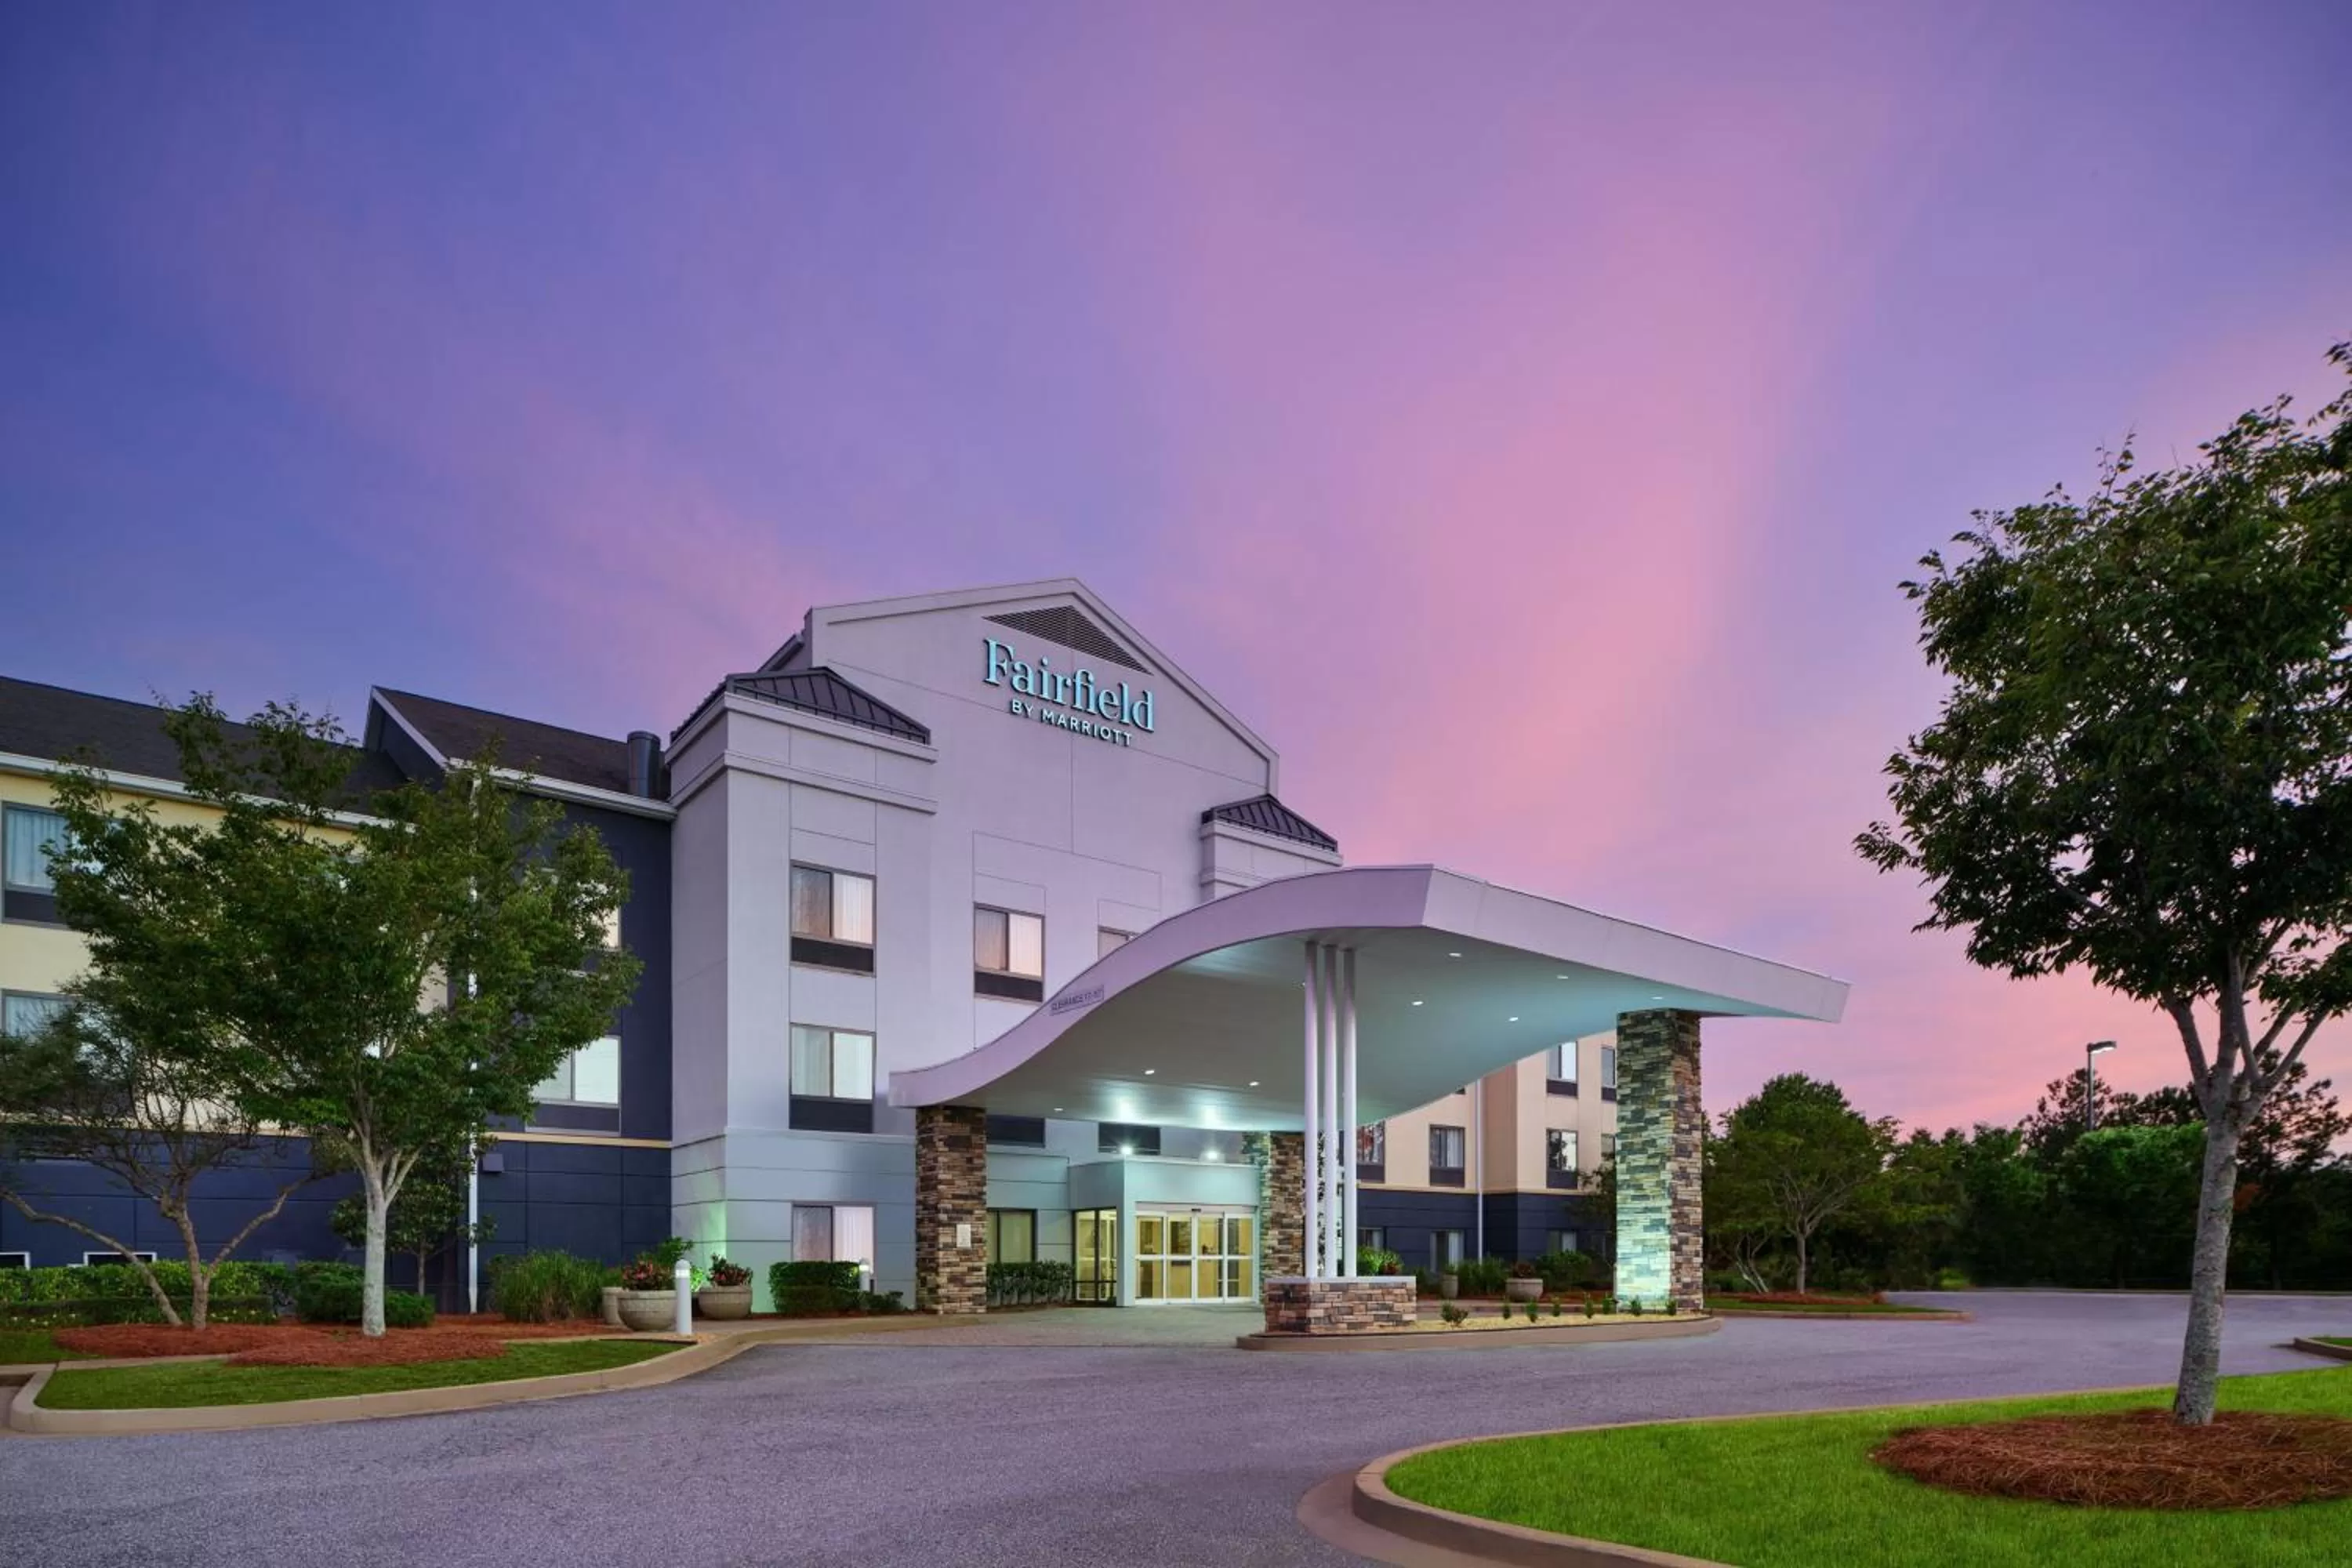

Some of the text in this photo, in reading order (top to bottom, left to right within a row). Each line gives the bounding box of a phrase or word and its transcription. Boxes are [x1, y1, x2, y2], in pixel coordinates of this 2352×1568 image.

[983, 637, 1155, 733] Fairfield
[1011, 699, 1133, 746] BY MARRIOTT
